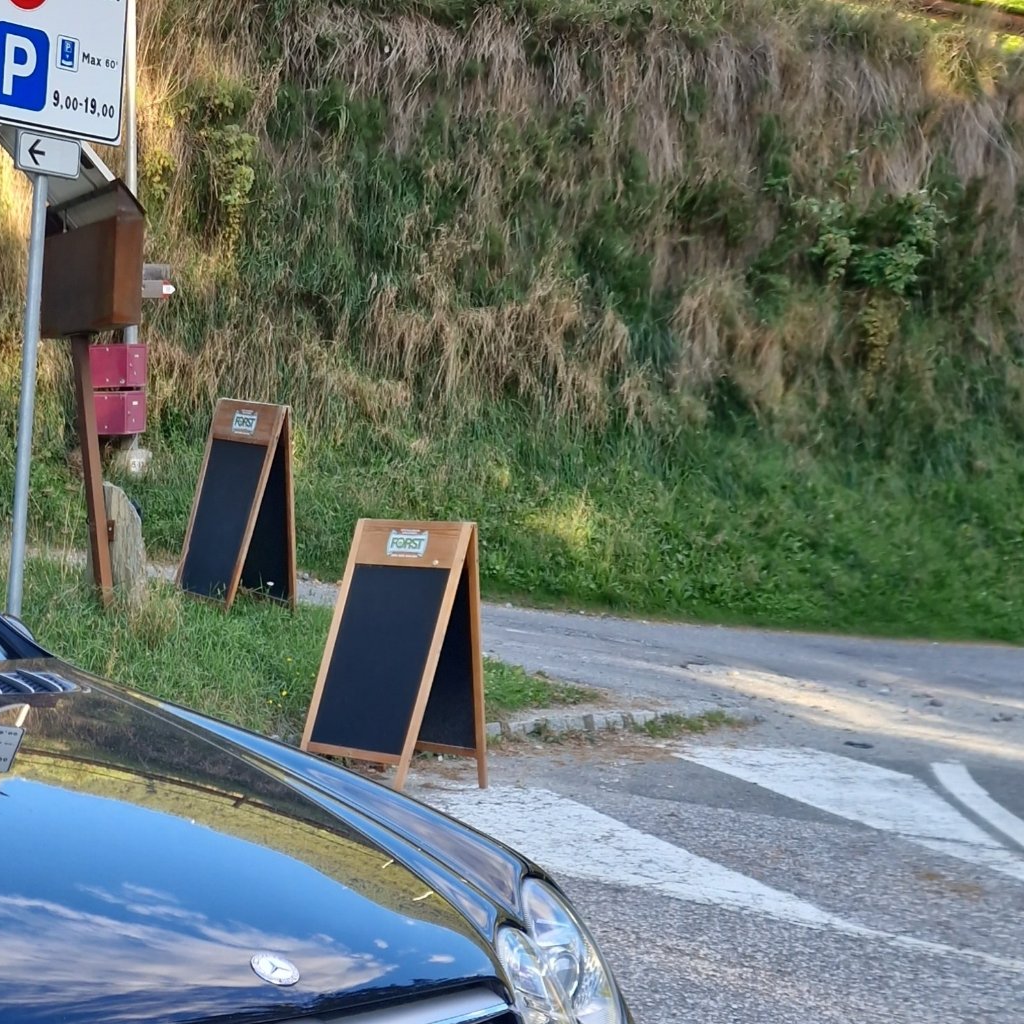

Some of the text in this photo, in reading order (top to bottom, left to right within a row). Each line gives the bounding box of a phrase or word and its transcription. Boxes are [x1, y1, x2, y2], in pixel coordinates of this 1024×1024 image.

[2, 33, 37, 96] P
[82, 52, 102, 67] Max
[390, 537, 425, 549] FORST
